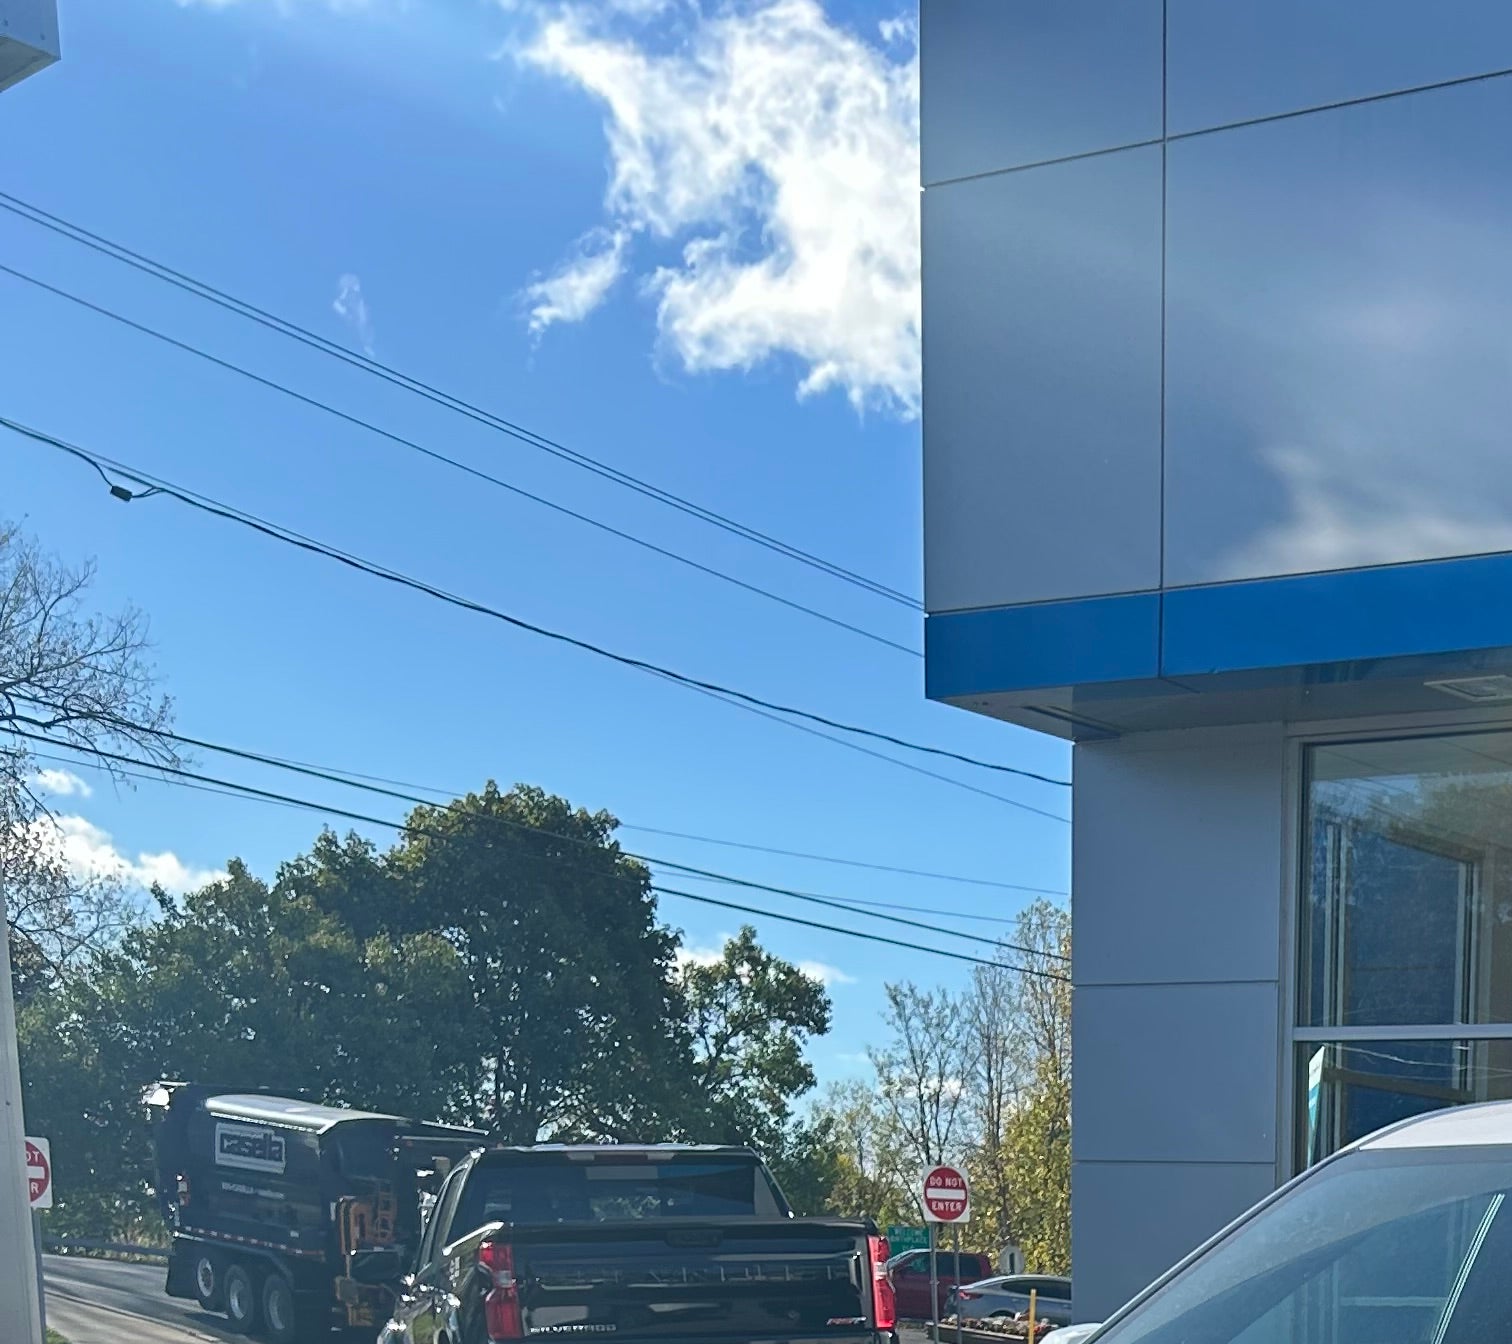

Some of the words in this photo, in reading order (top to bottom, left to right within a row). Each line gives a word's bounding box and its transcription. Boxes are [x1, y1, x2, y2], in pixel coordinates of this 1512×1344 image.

[929, 1175, 943, 1187] DO
[945, 1176, 963, 1188] NOT
[931, 1201, 963, 1212] ENTER
